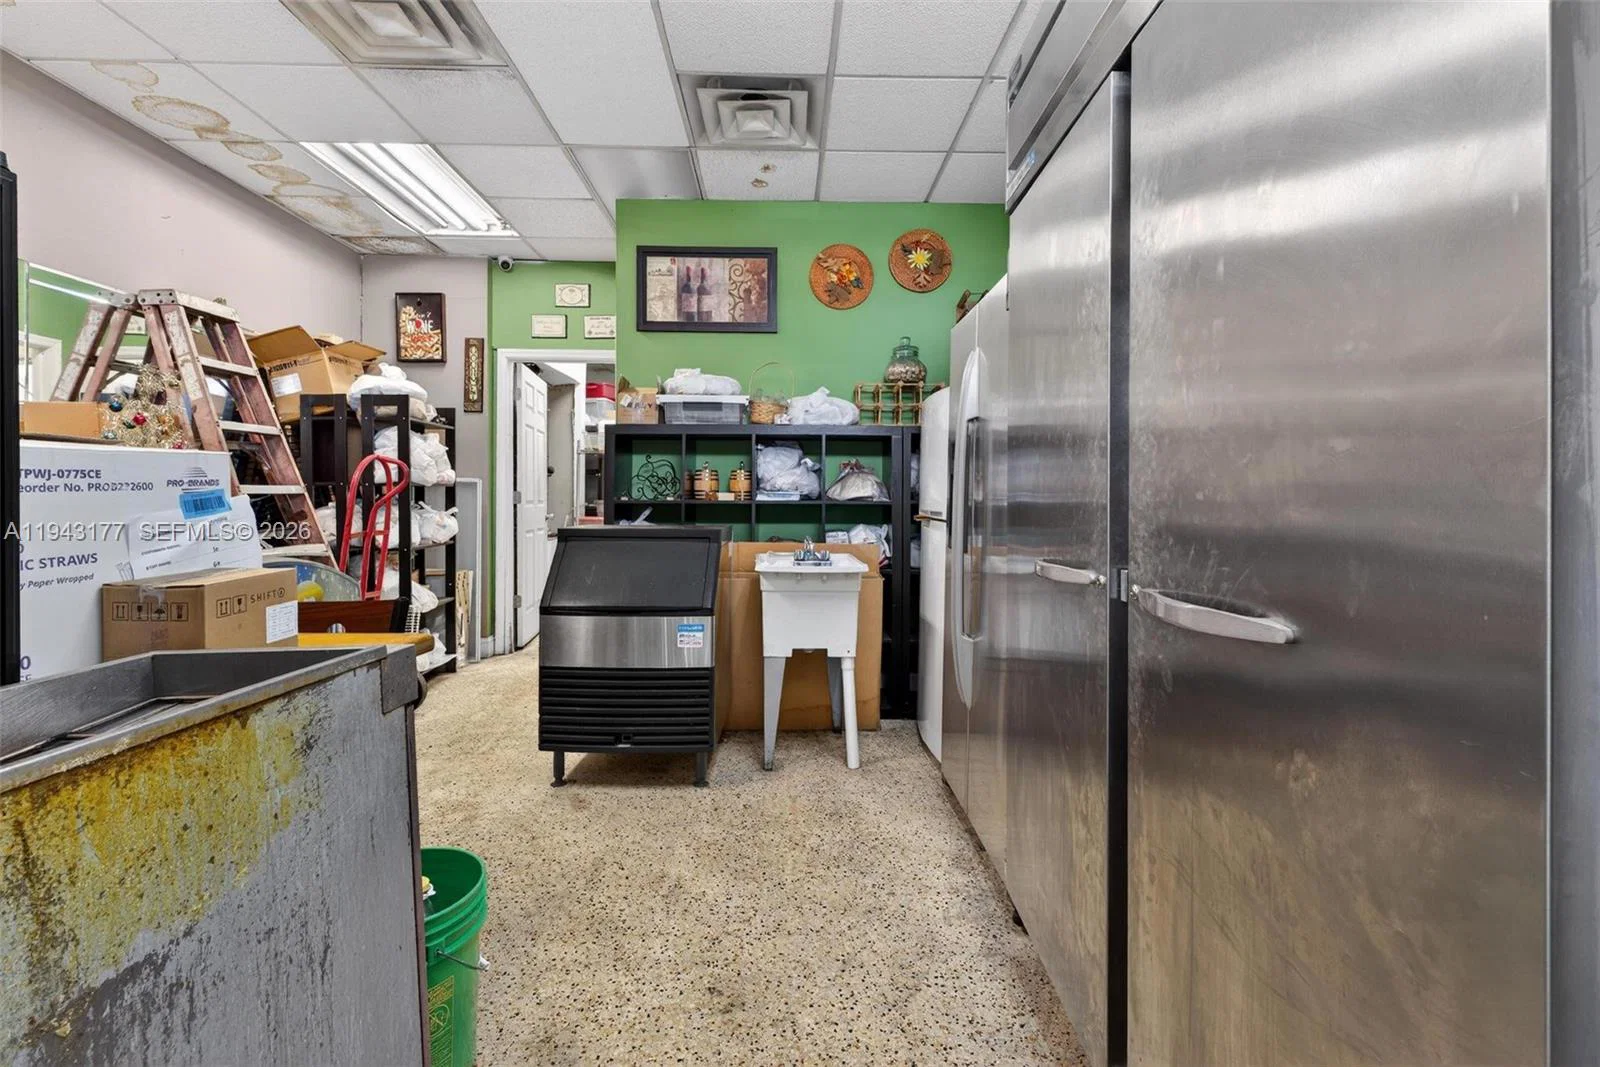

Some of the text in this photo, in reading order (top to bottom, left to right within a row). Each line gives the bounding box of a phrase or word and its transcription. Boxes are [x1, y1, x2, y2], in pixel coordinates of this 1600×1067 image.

[63, 483, 84, 492] No.
[39, 553, 98, 568] STRAWS
[56, 573, 94, 584] Wrapped
